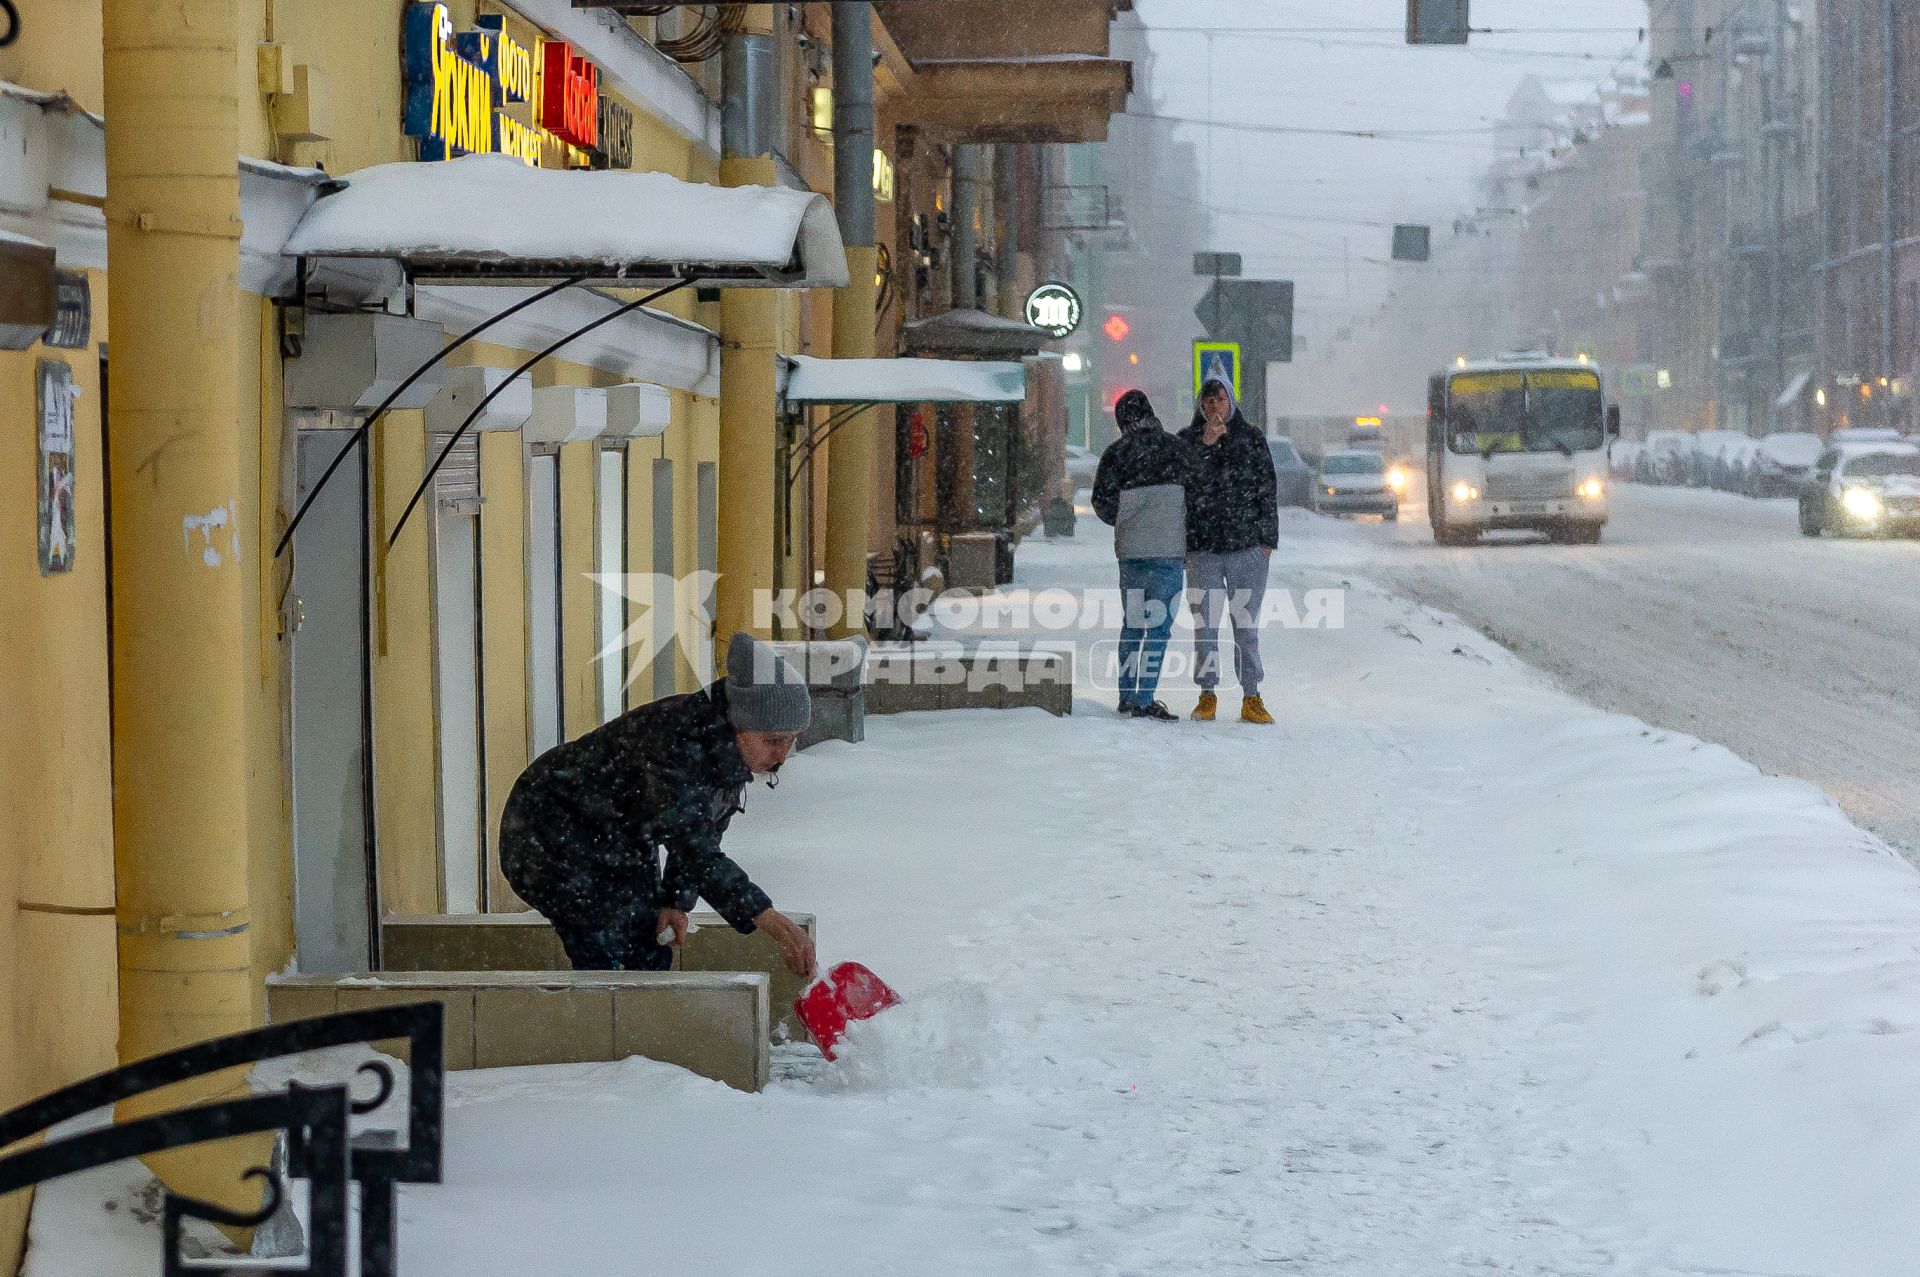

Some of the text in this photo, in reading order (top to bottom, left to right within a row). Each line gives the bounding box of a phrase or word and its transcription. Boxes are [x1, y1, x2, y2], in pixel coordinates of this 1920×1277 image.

[431, 4, 492, 161] Яркий
[498, 16, 531, 105] фото
[563, 42, 598, 148] Kodak
[499, 112, 543, 168] маркет
